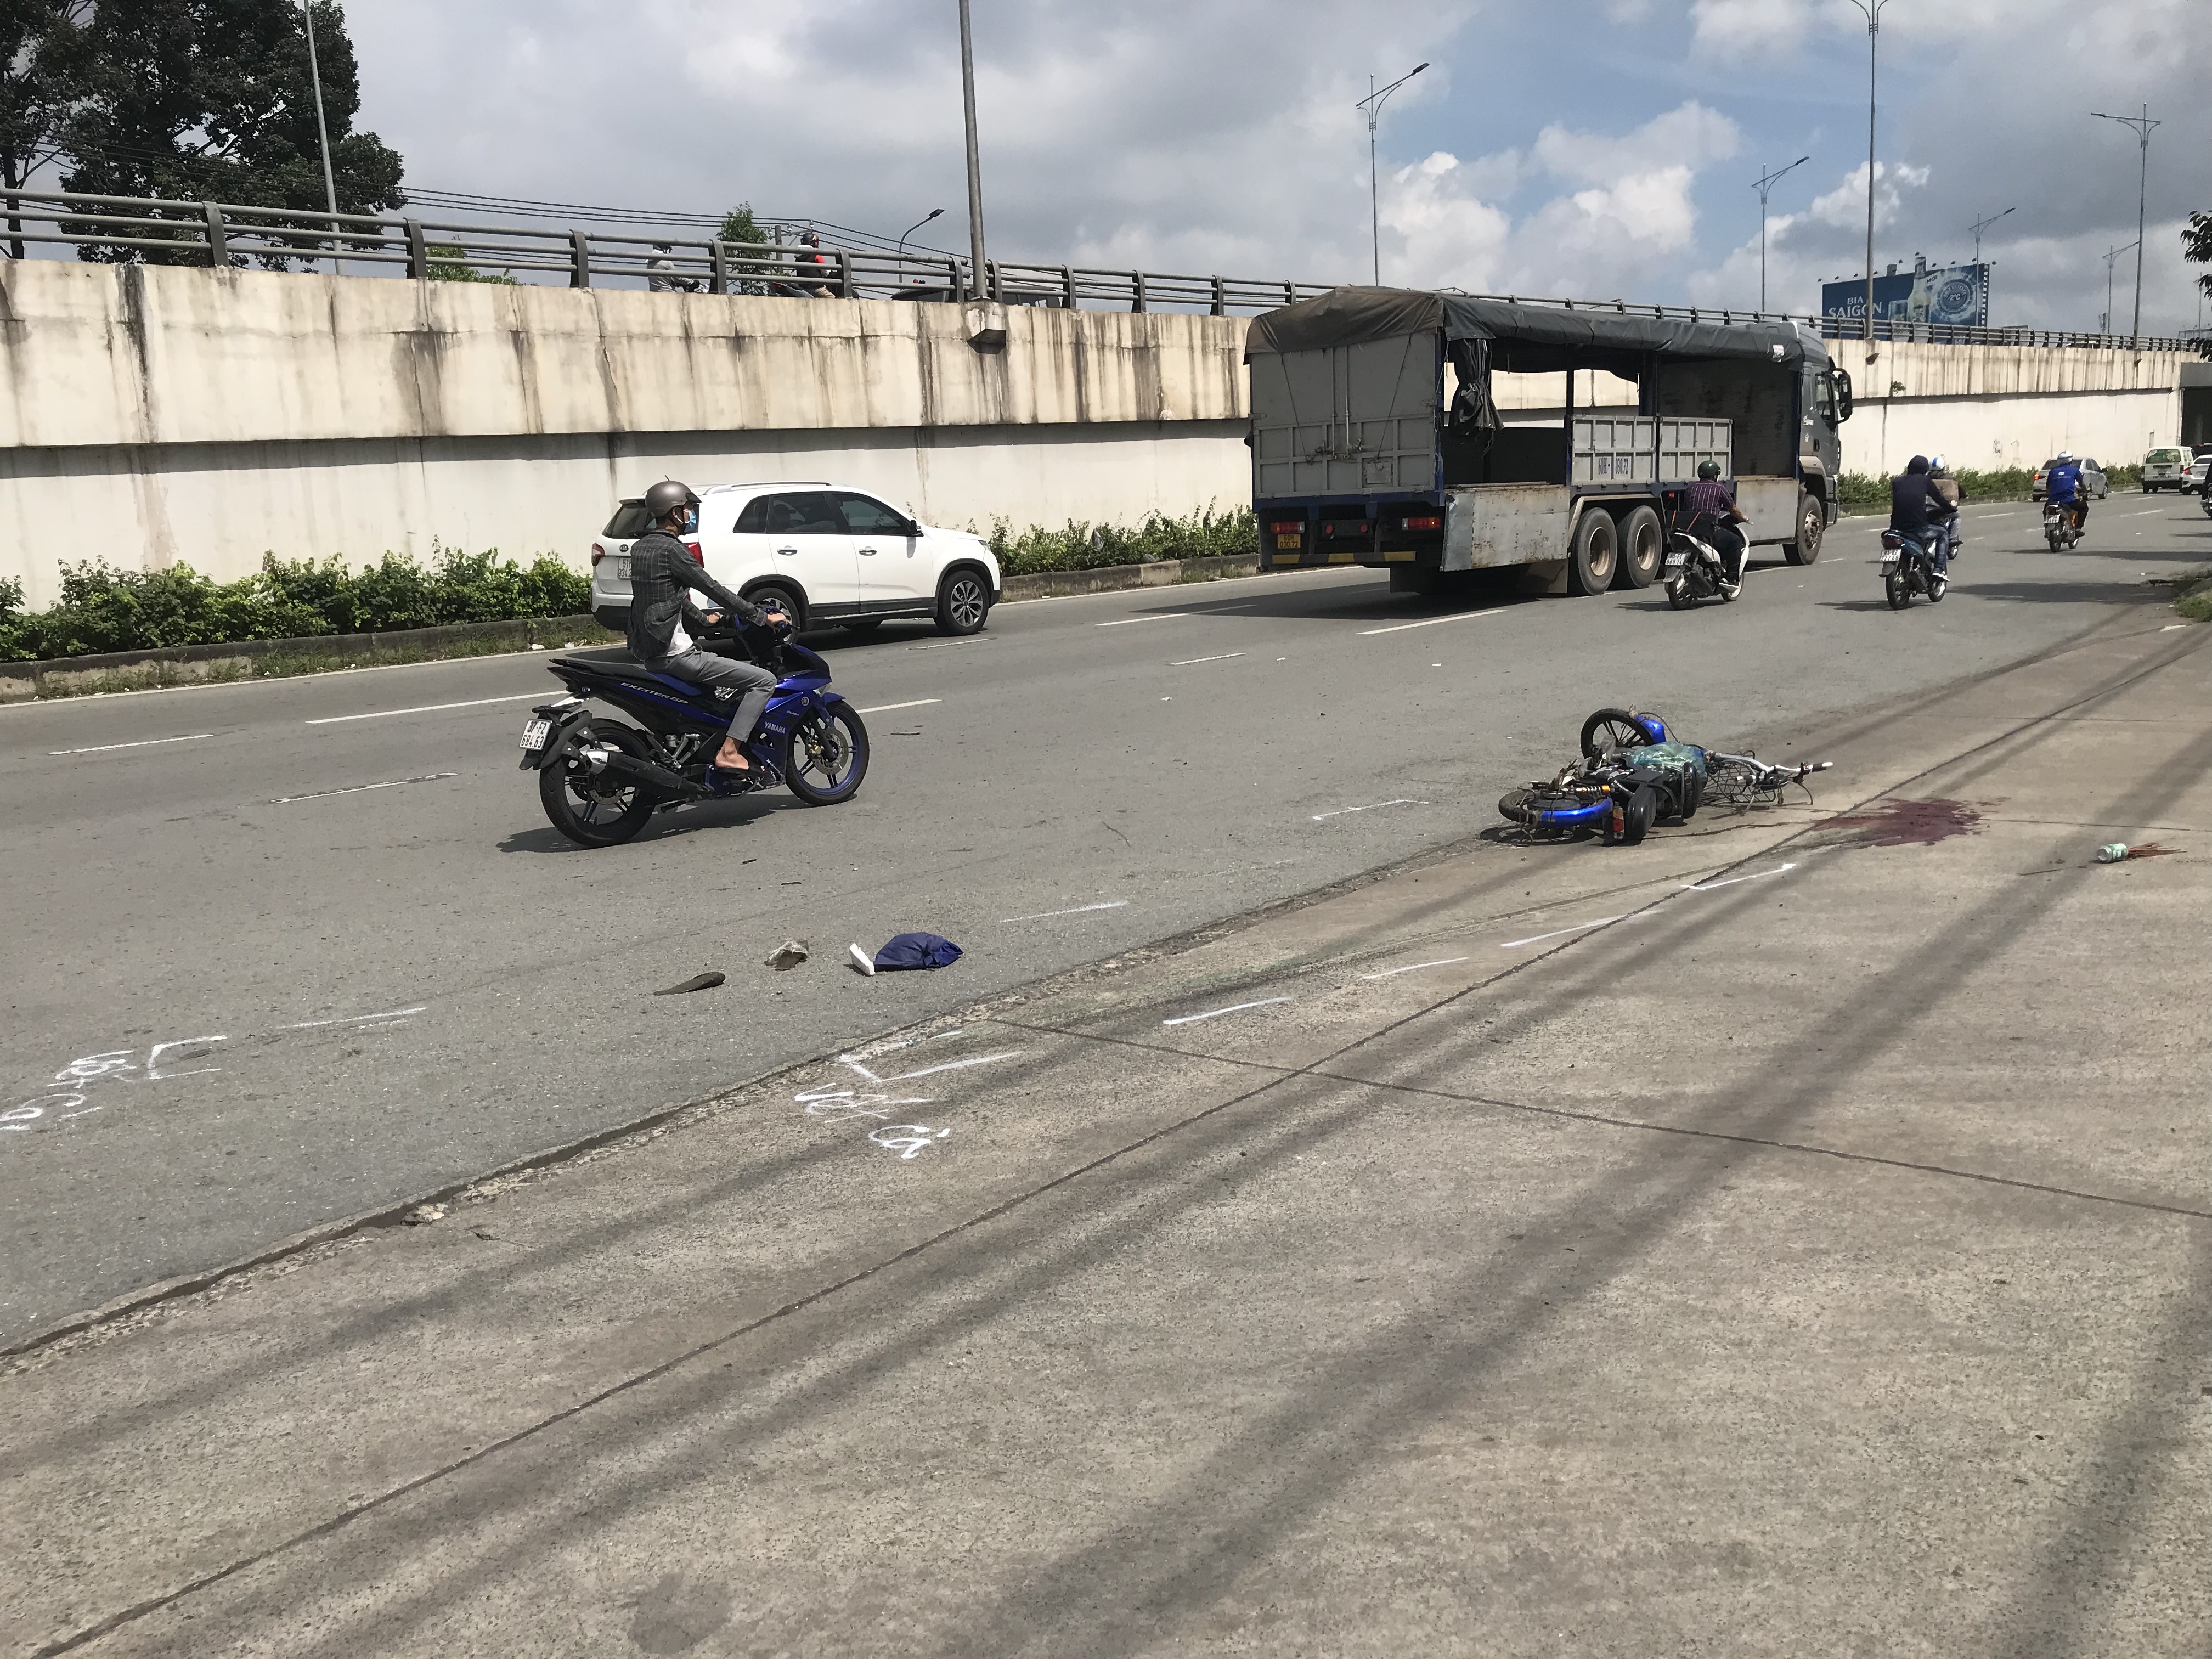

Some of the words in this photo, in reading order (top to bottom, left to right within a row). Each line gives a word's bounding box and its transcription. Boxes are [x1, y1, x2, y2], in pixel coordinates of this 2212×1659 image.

[1847, 296, 1864, 304] BIA
[620, 682, 670, 699] EXCITER
[527, 721, 547, 735] 37-F2
[765, 721, 786, 735] YAMAHA
[521, 735, 544, 748] 684.63
